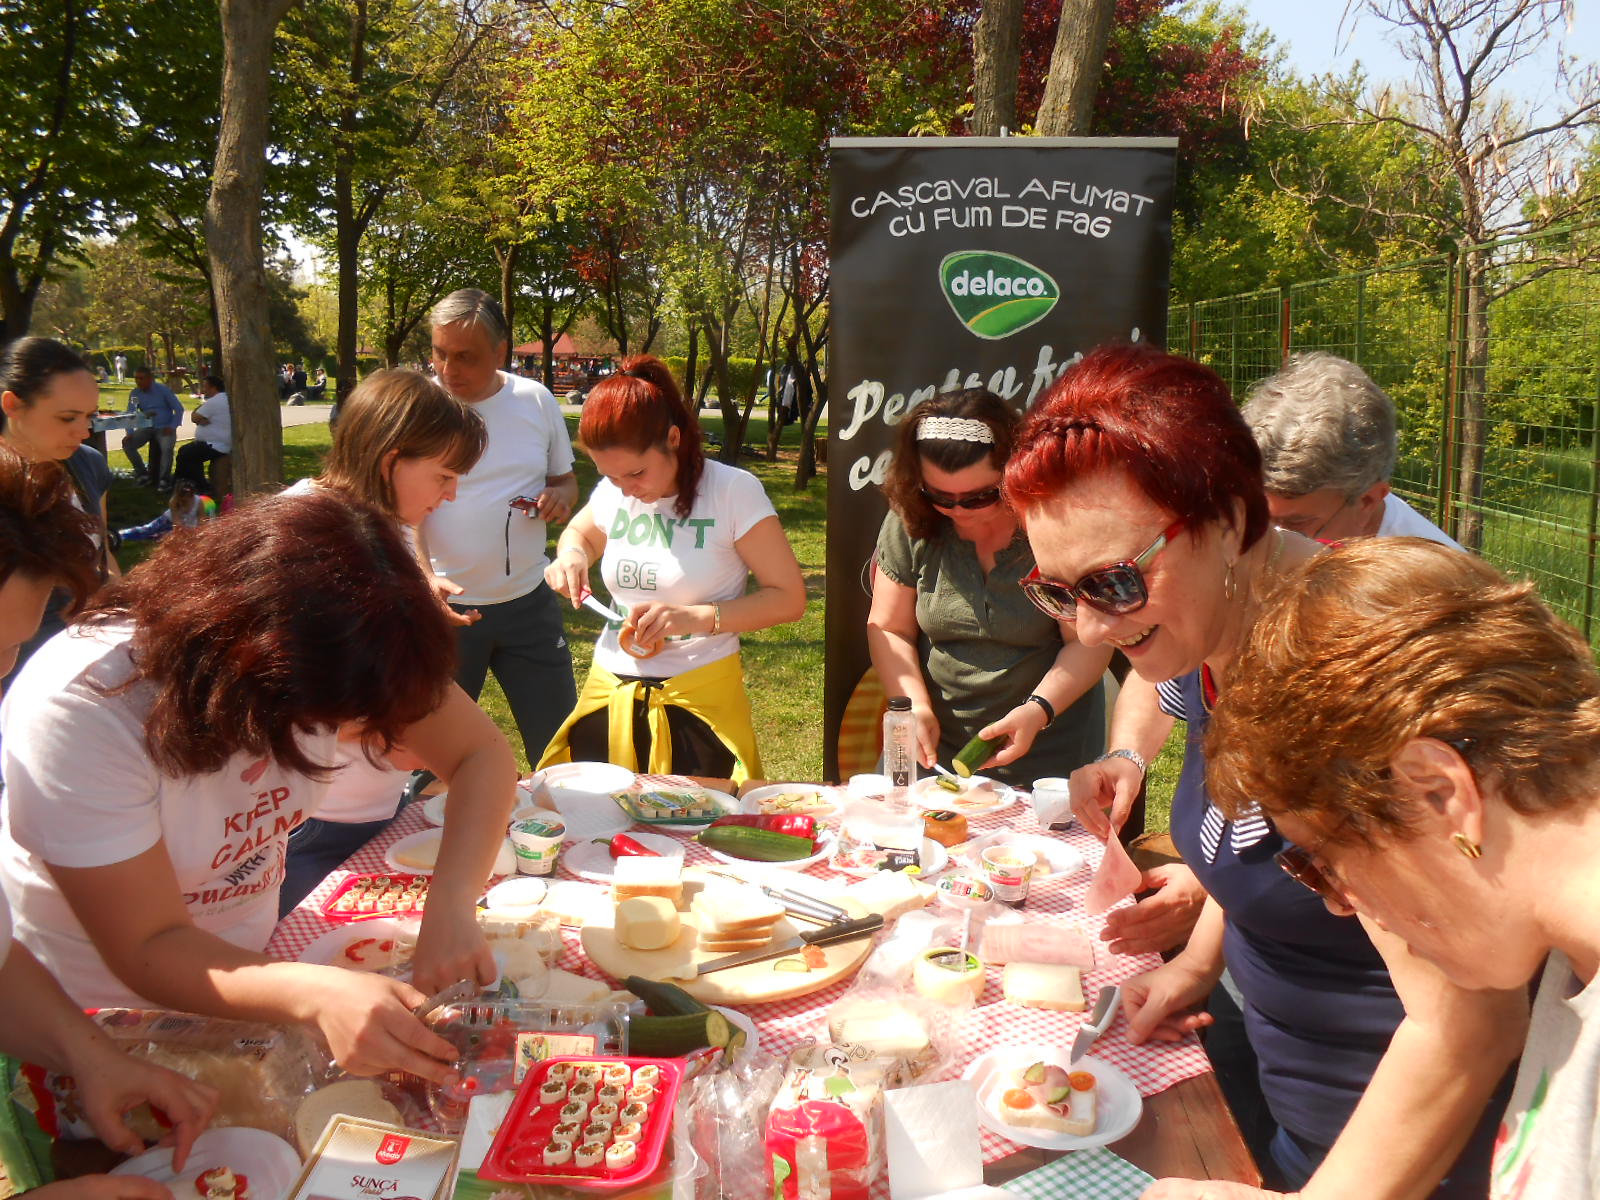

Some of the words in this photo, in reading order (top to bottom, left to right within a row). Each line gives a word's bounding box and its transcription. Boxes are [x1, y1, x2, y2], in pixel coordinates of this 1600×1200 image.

[1001, 205, 1048, 230] DE
[609, 507, 716, 549] DON'T
[616, 559, 658, 591] BE
[211, 808, 303, 870] CALM
[224, 852, 267, 887] WITH
